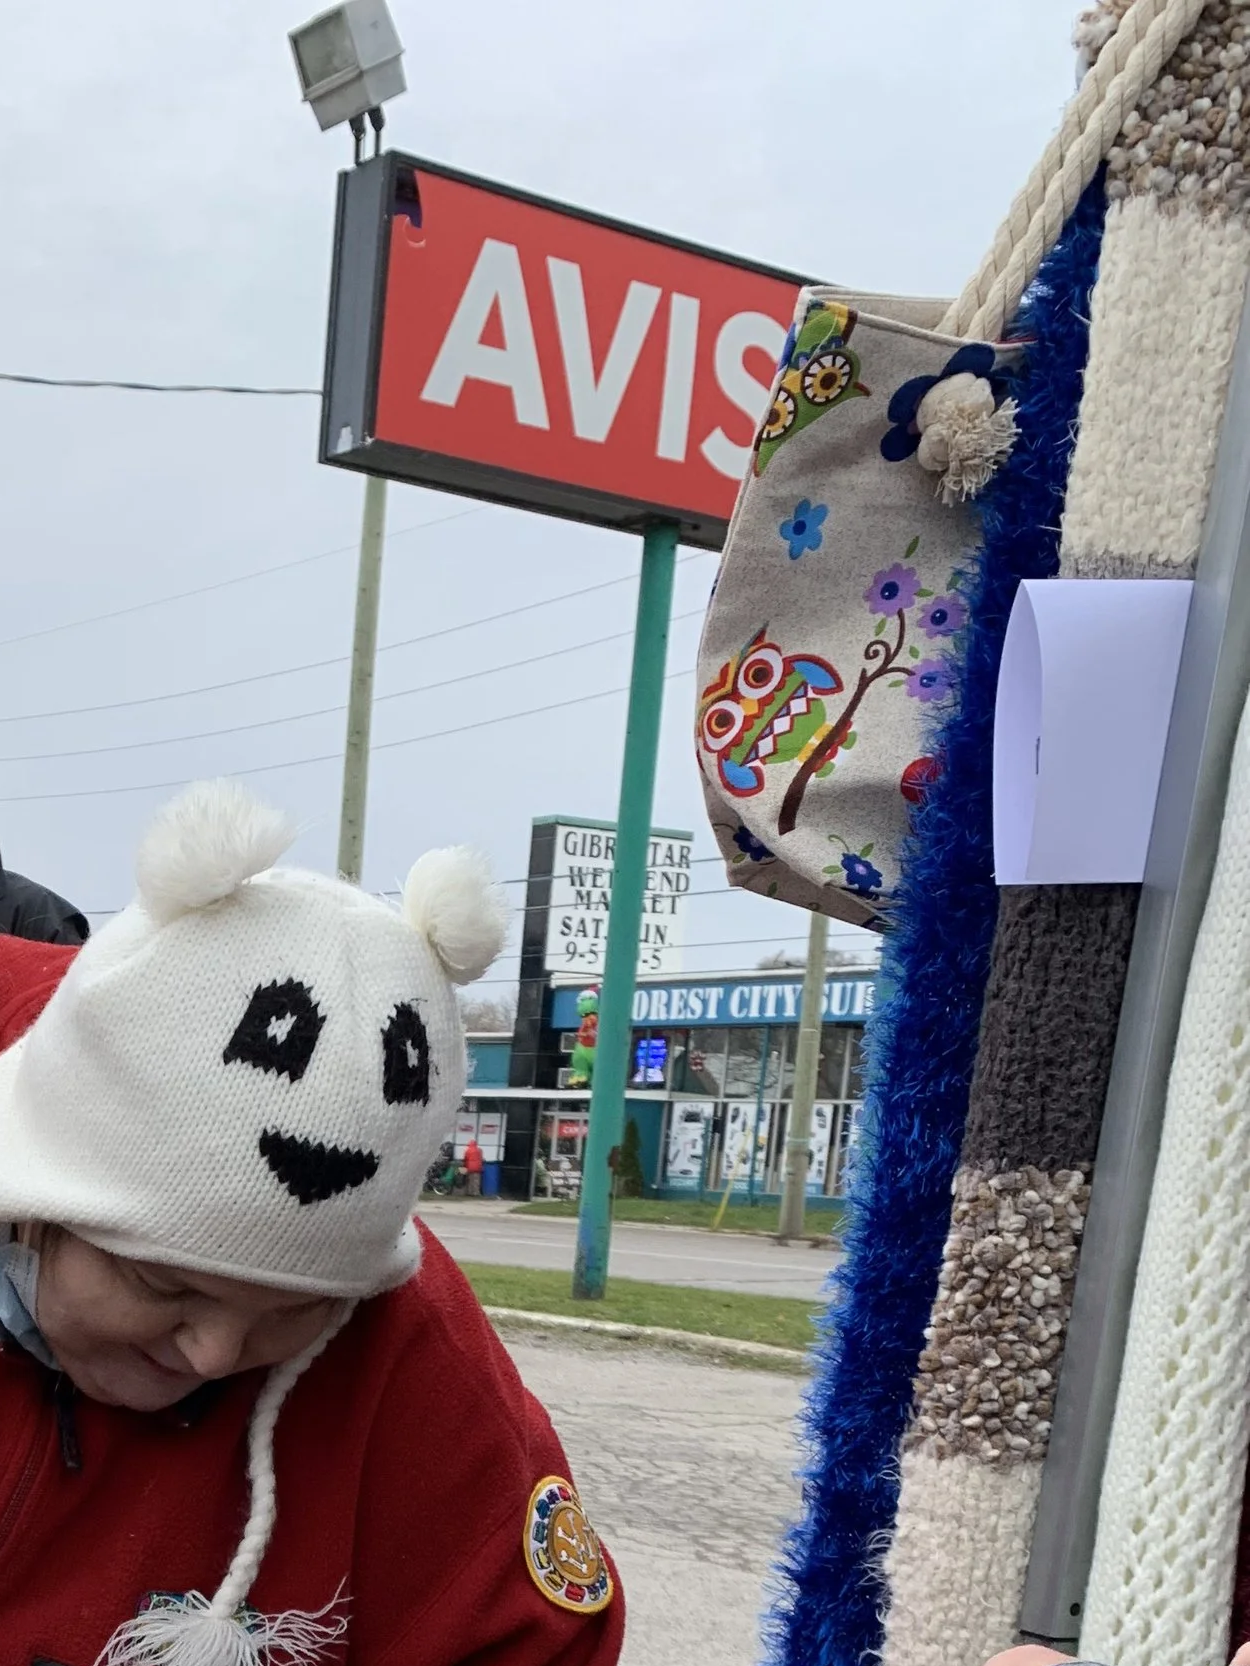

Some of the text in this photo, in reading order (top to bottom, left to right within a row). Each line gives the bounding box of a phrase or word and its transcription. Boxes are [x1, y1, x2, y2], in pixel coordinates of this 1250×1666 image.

[420, 237, 789, 481] AVIS
[563, 831, 691, 869] GIBRTAR
[568, 865, 691, 893] WEEND
[574, 889, 681, 915] MAET
[565, 940, 599, 965] 9-5
[632, 986, 724, 1021] OREST
[729, 983, 804, 1018] CITY
